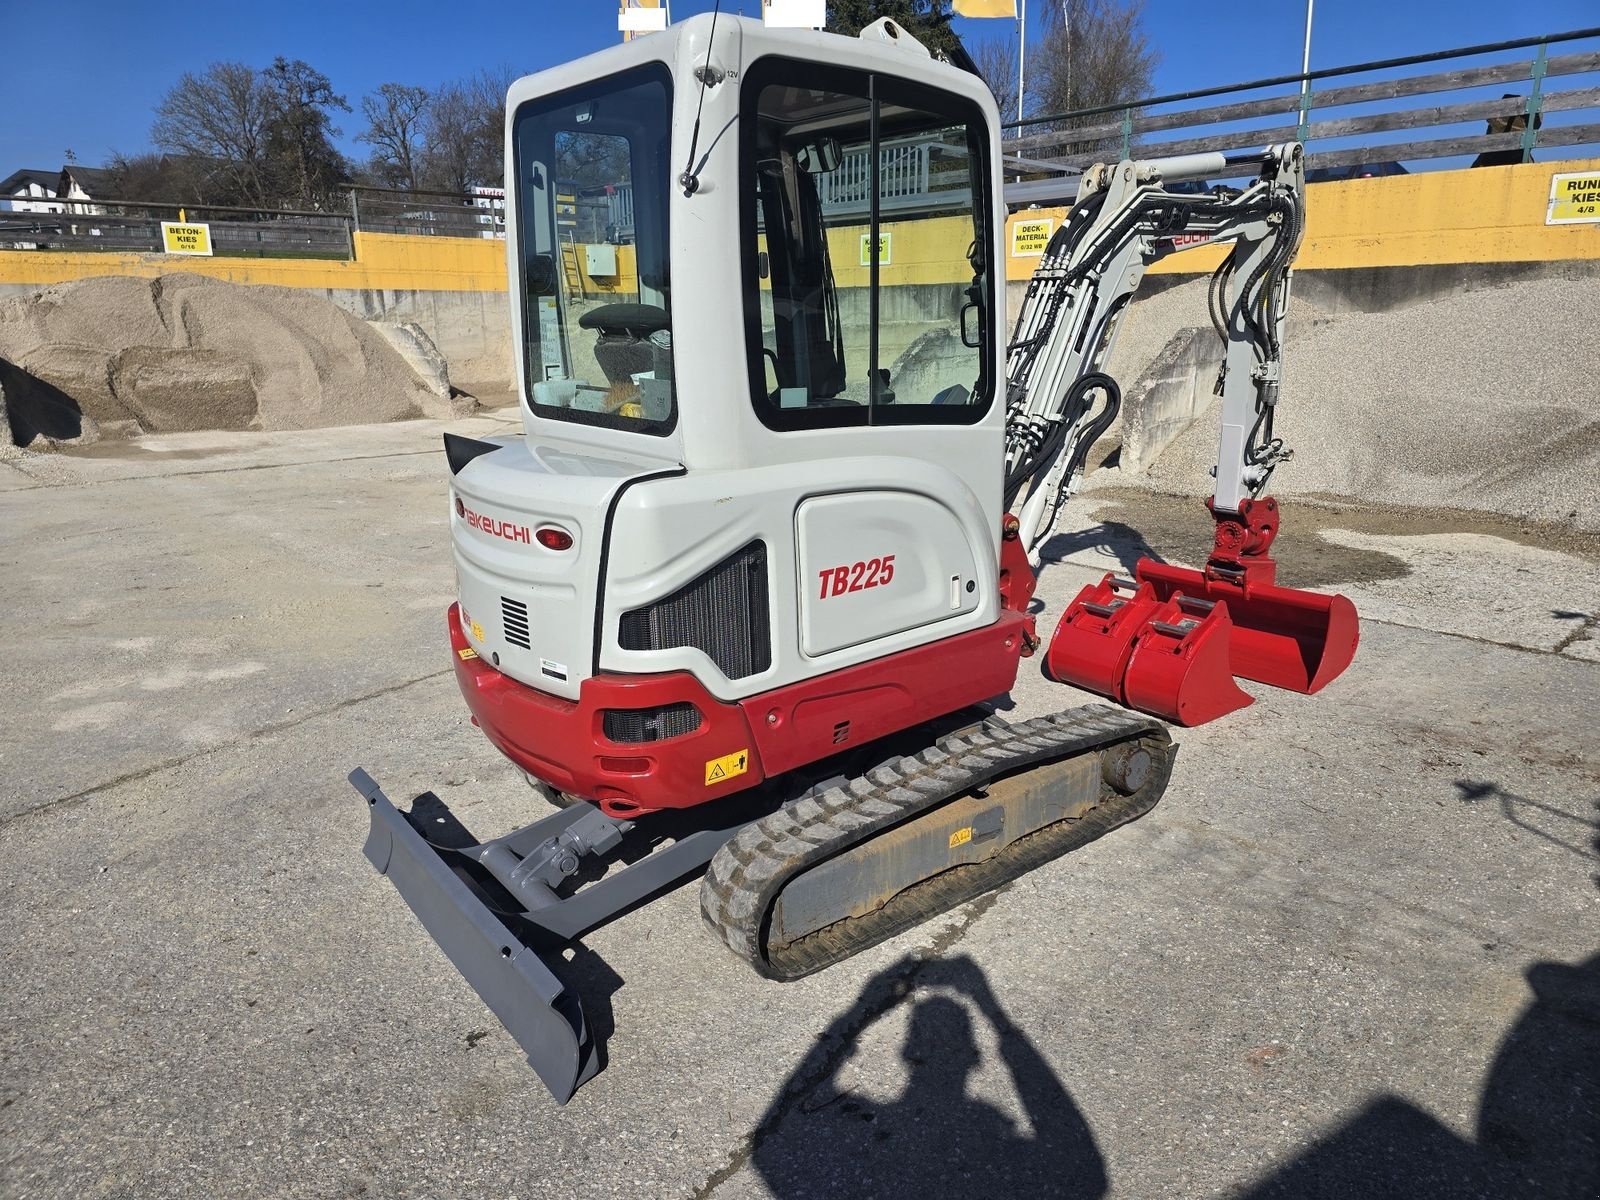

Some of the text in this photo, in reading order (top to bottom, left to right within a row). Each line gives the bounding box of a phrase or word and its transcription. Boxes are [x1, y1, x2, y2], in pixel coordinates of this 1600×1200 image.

[727, 70, 738, 78] 12V
[169, 227, 202, 235] BETON-
[1022, 225, 1043, 233] DECK-
[1016, 233, 1048, 242] MATERIAL
[464, 508, 531, 545] TAKEUCHI
[819, 555, 896, 600] TB225
